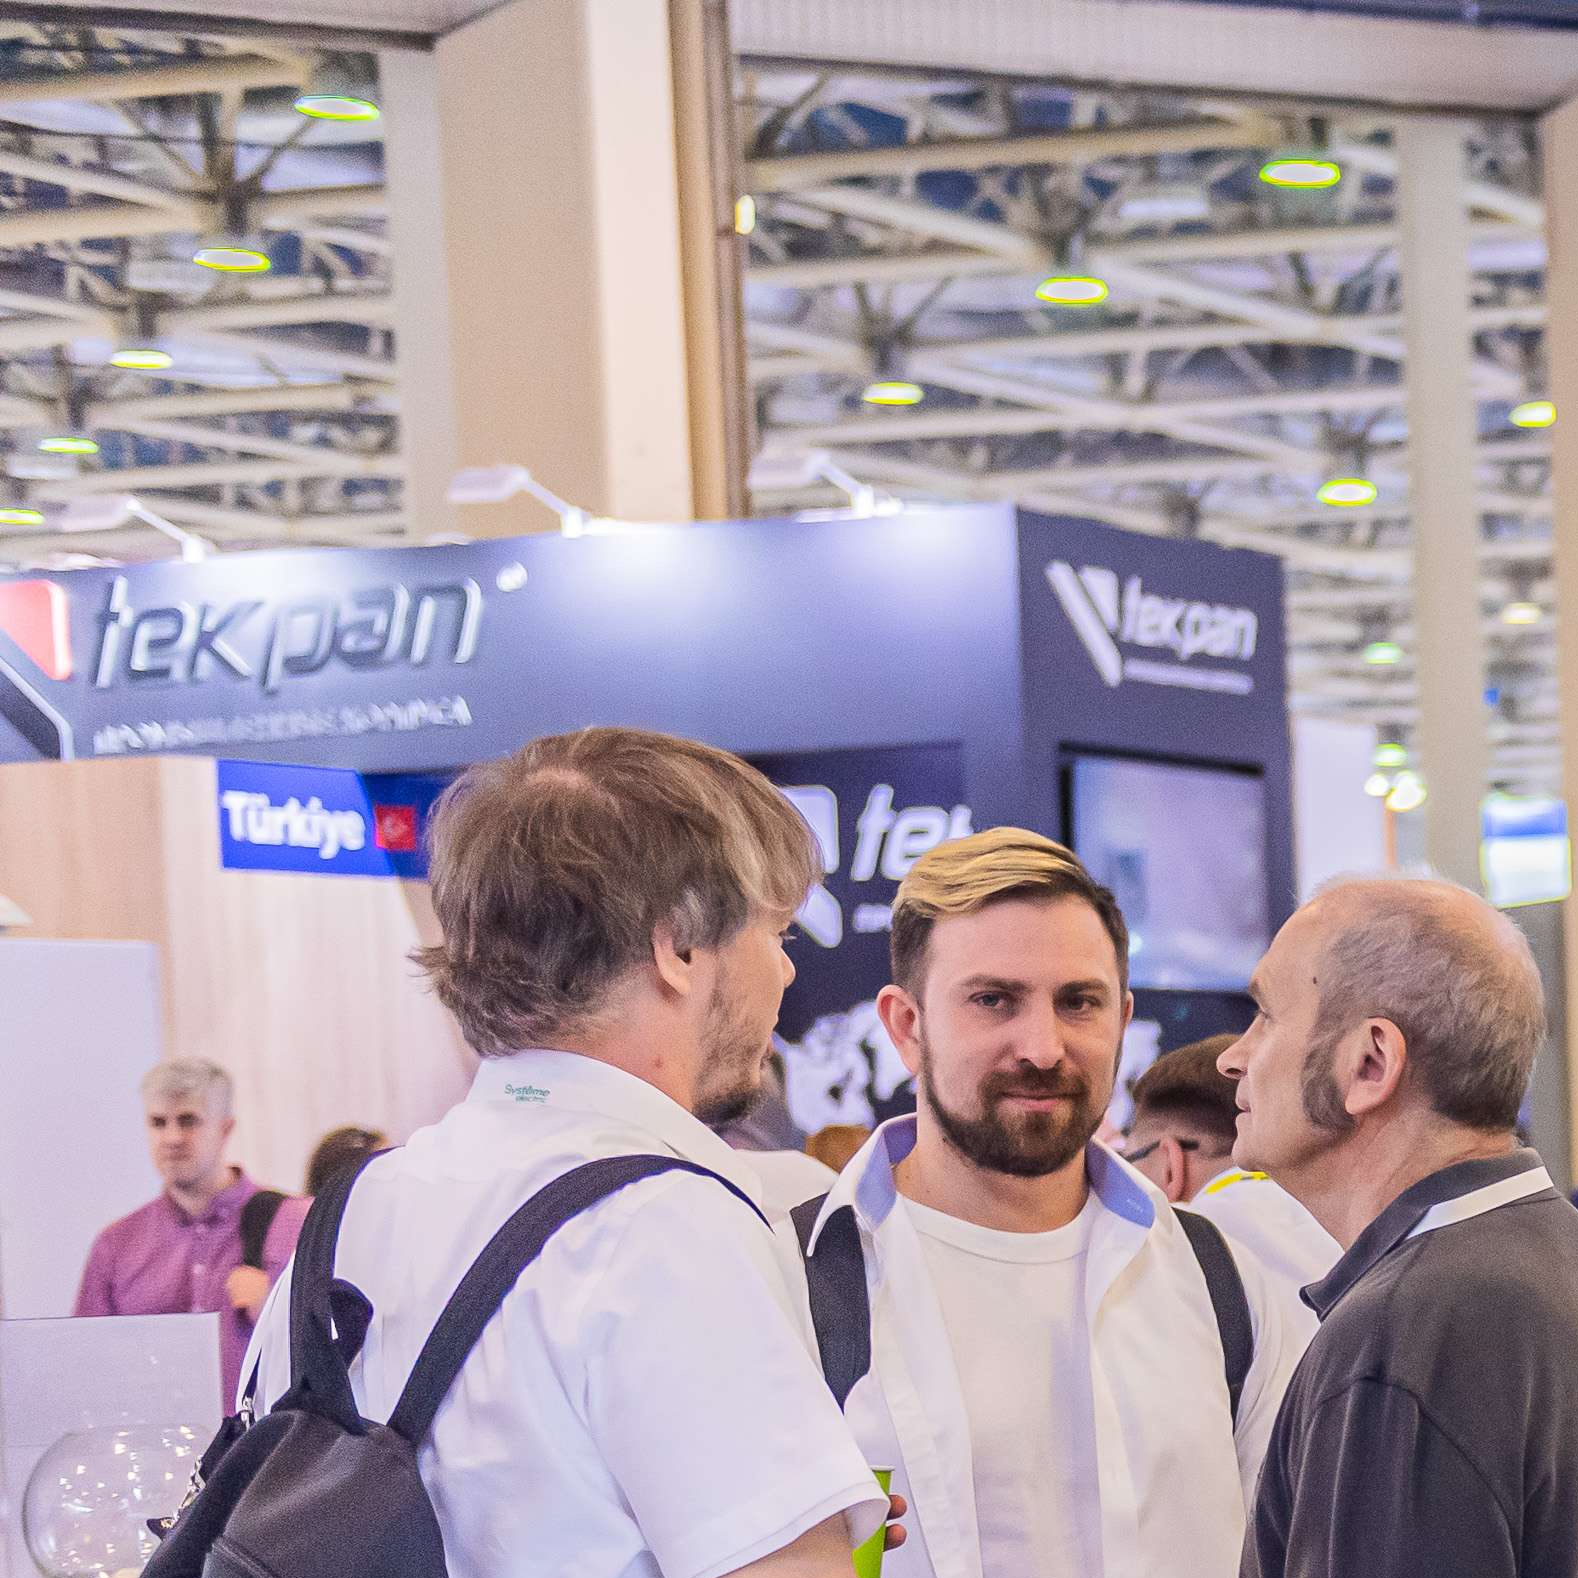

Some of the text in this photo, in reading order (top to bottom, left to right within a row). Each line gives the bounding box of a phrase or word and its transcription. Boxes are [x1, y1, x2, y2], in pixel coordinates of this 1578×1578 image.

[94, 573, 482, 694] tekpan
[1123, 575, 1258, 661] tekpan
[222, 789, 367, 861] Türkiye
